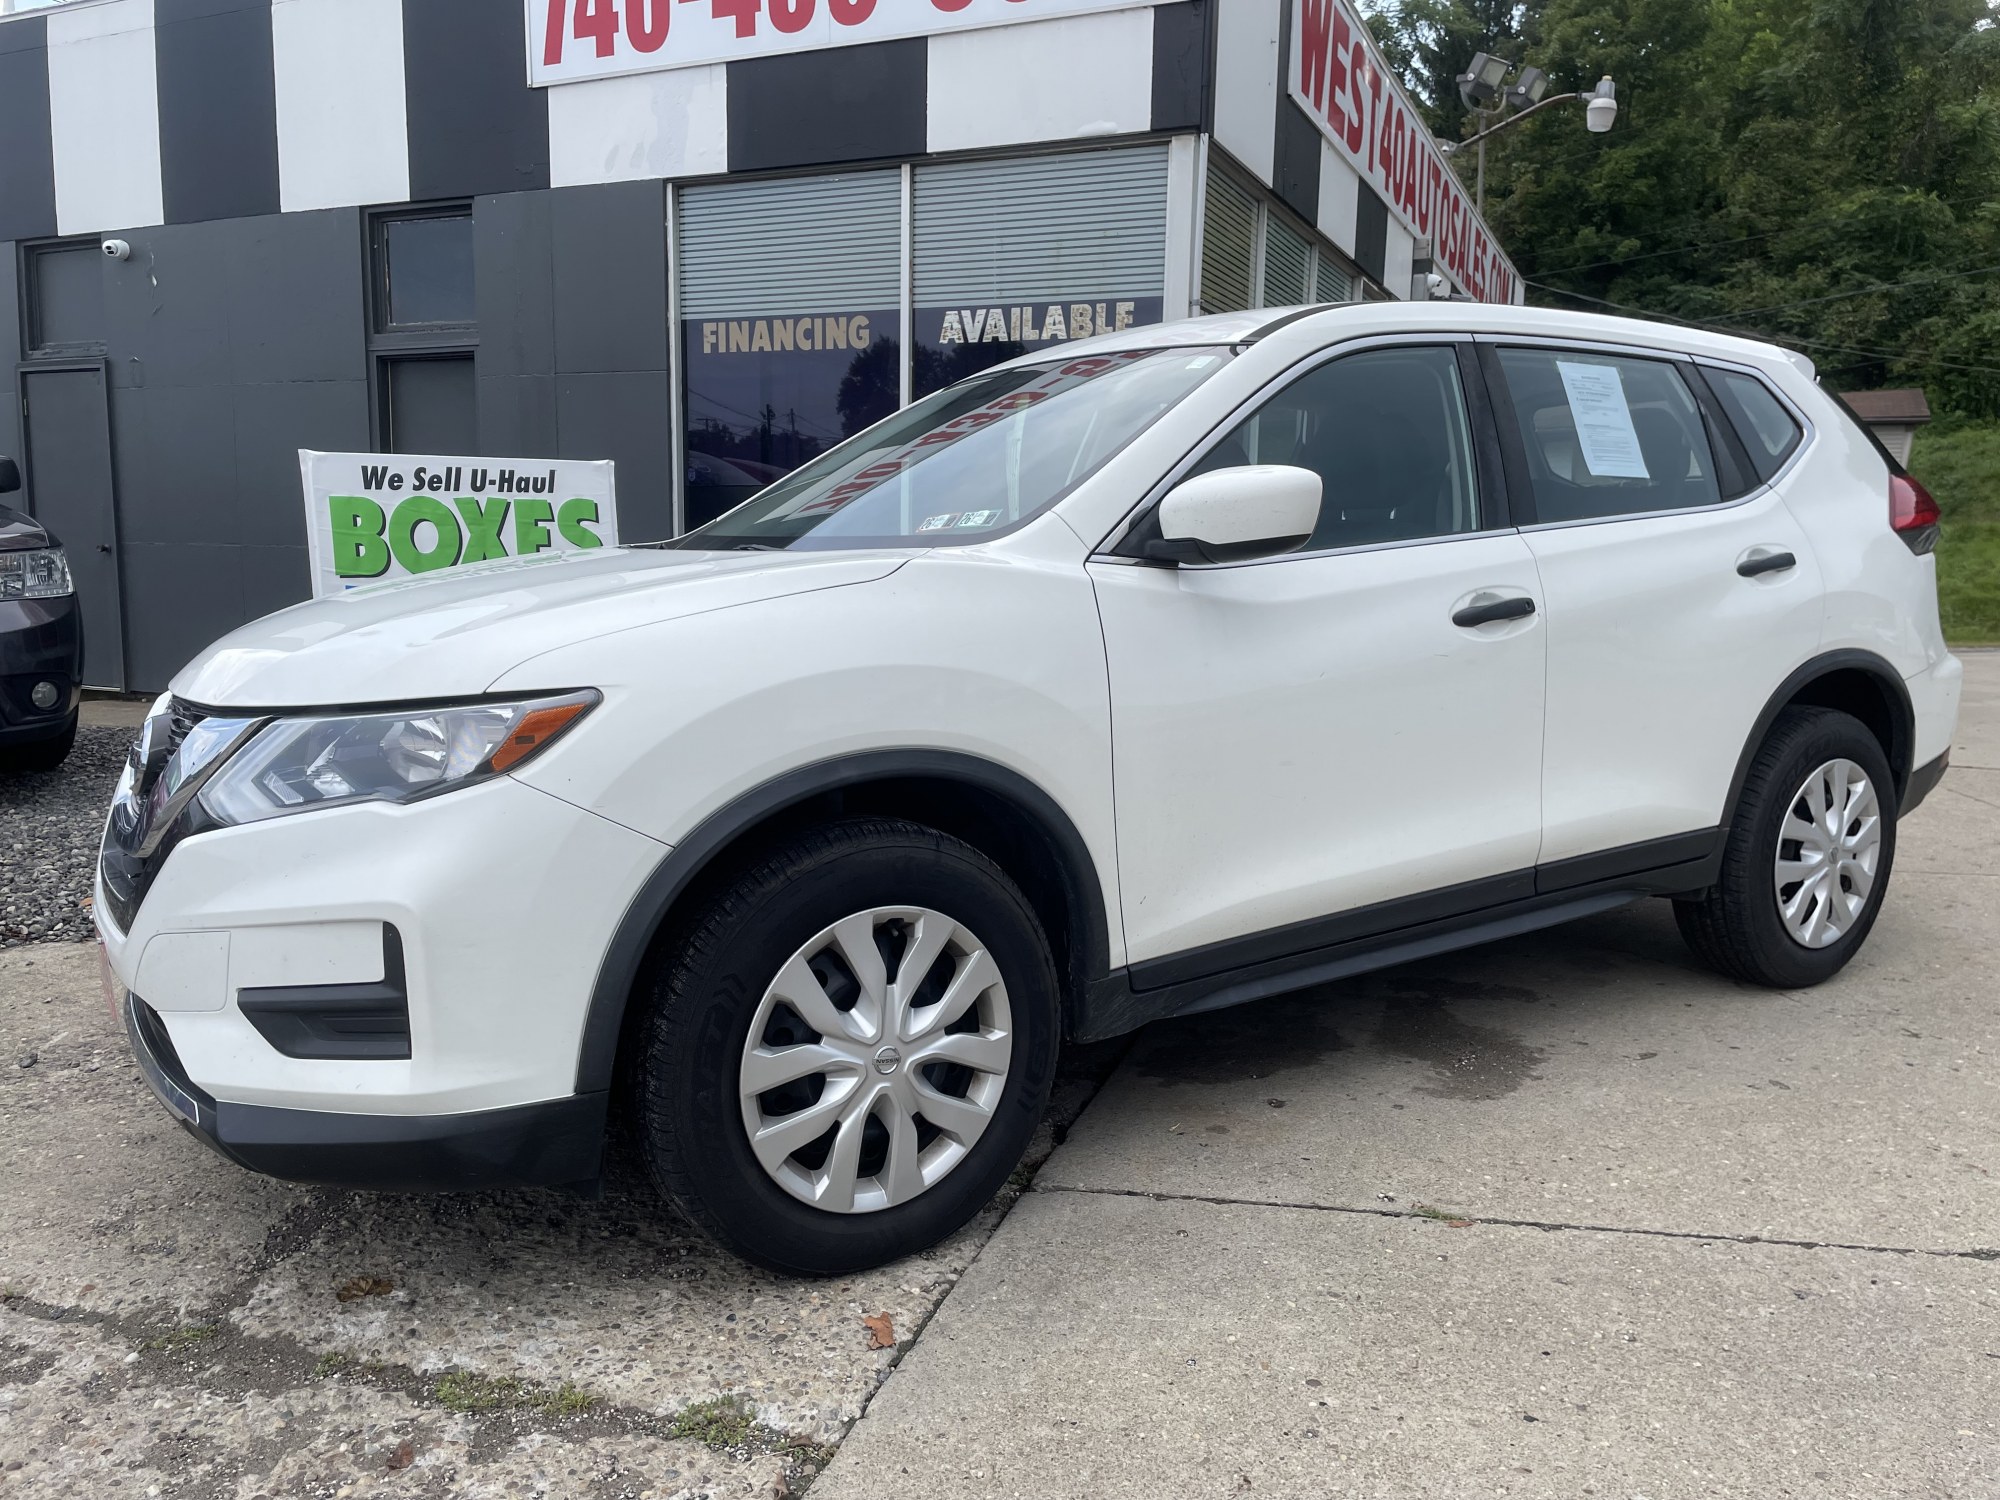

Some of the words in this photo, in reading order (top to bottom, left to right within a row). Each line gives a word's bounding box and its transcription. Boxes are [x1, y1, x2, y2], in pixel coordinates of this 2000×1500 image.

[703, 315, 870, 354] FINANCING
[939, 302, 1134, 344] AVAILABLE
[361, 465, 404, 491] We
[412, 466, 462, 492] Sell
[470, 468, 556, 494] U-Haul
[328, 495, 603, 578] BOXES
